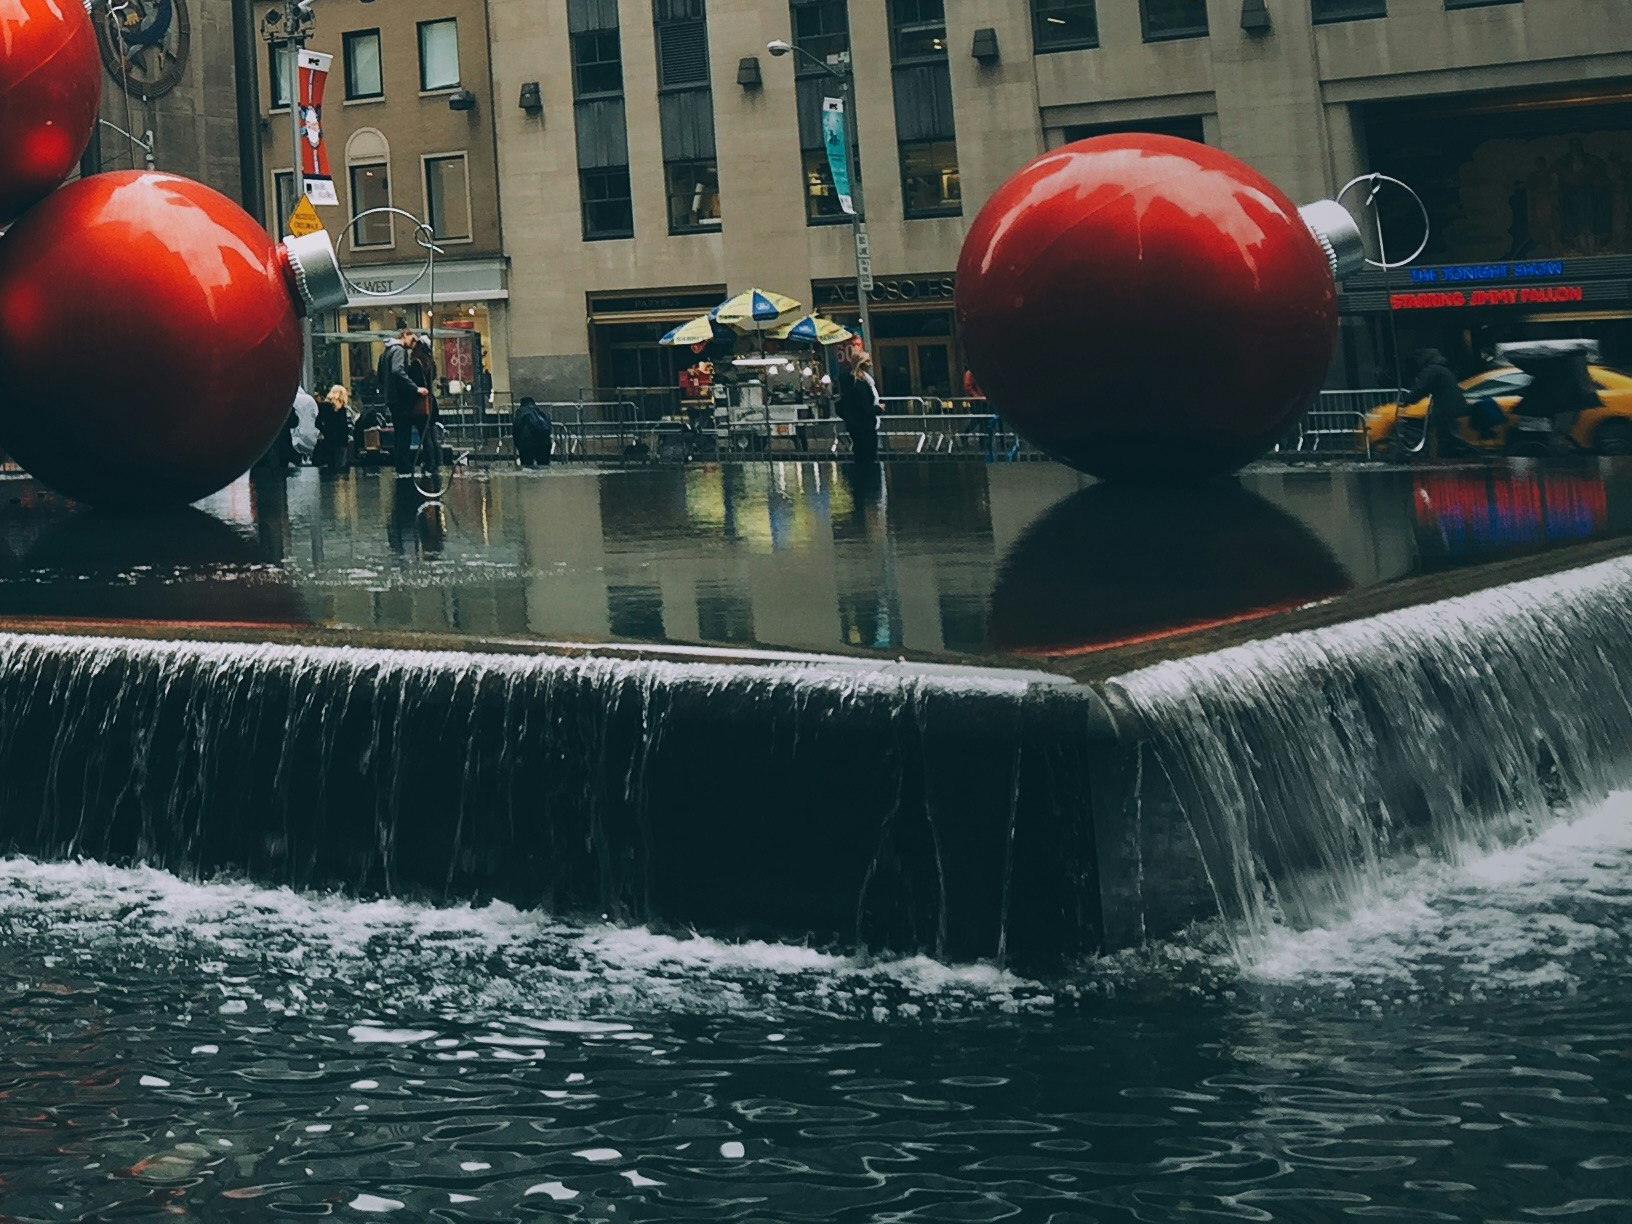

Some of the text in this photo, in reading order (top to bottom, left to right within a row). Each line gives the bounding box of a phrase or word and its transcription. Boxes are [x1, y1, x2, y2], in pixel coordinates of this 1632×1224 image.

[1410, 260, 1563, 283] THE TONIGHT SHOW
[363, 280, 394, 293] WEST
[830, 277, 955, 302] AEOSOLES
[1390, 285, 1583, 309] STARRING JIMMY FALLON
